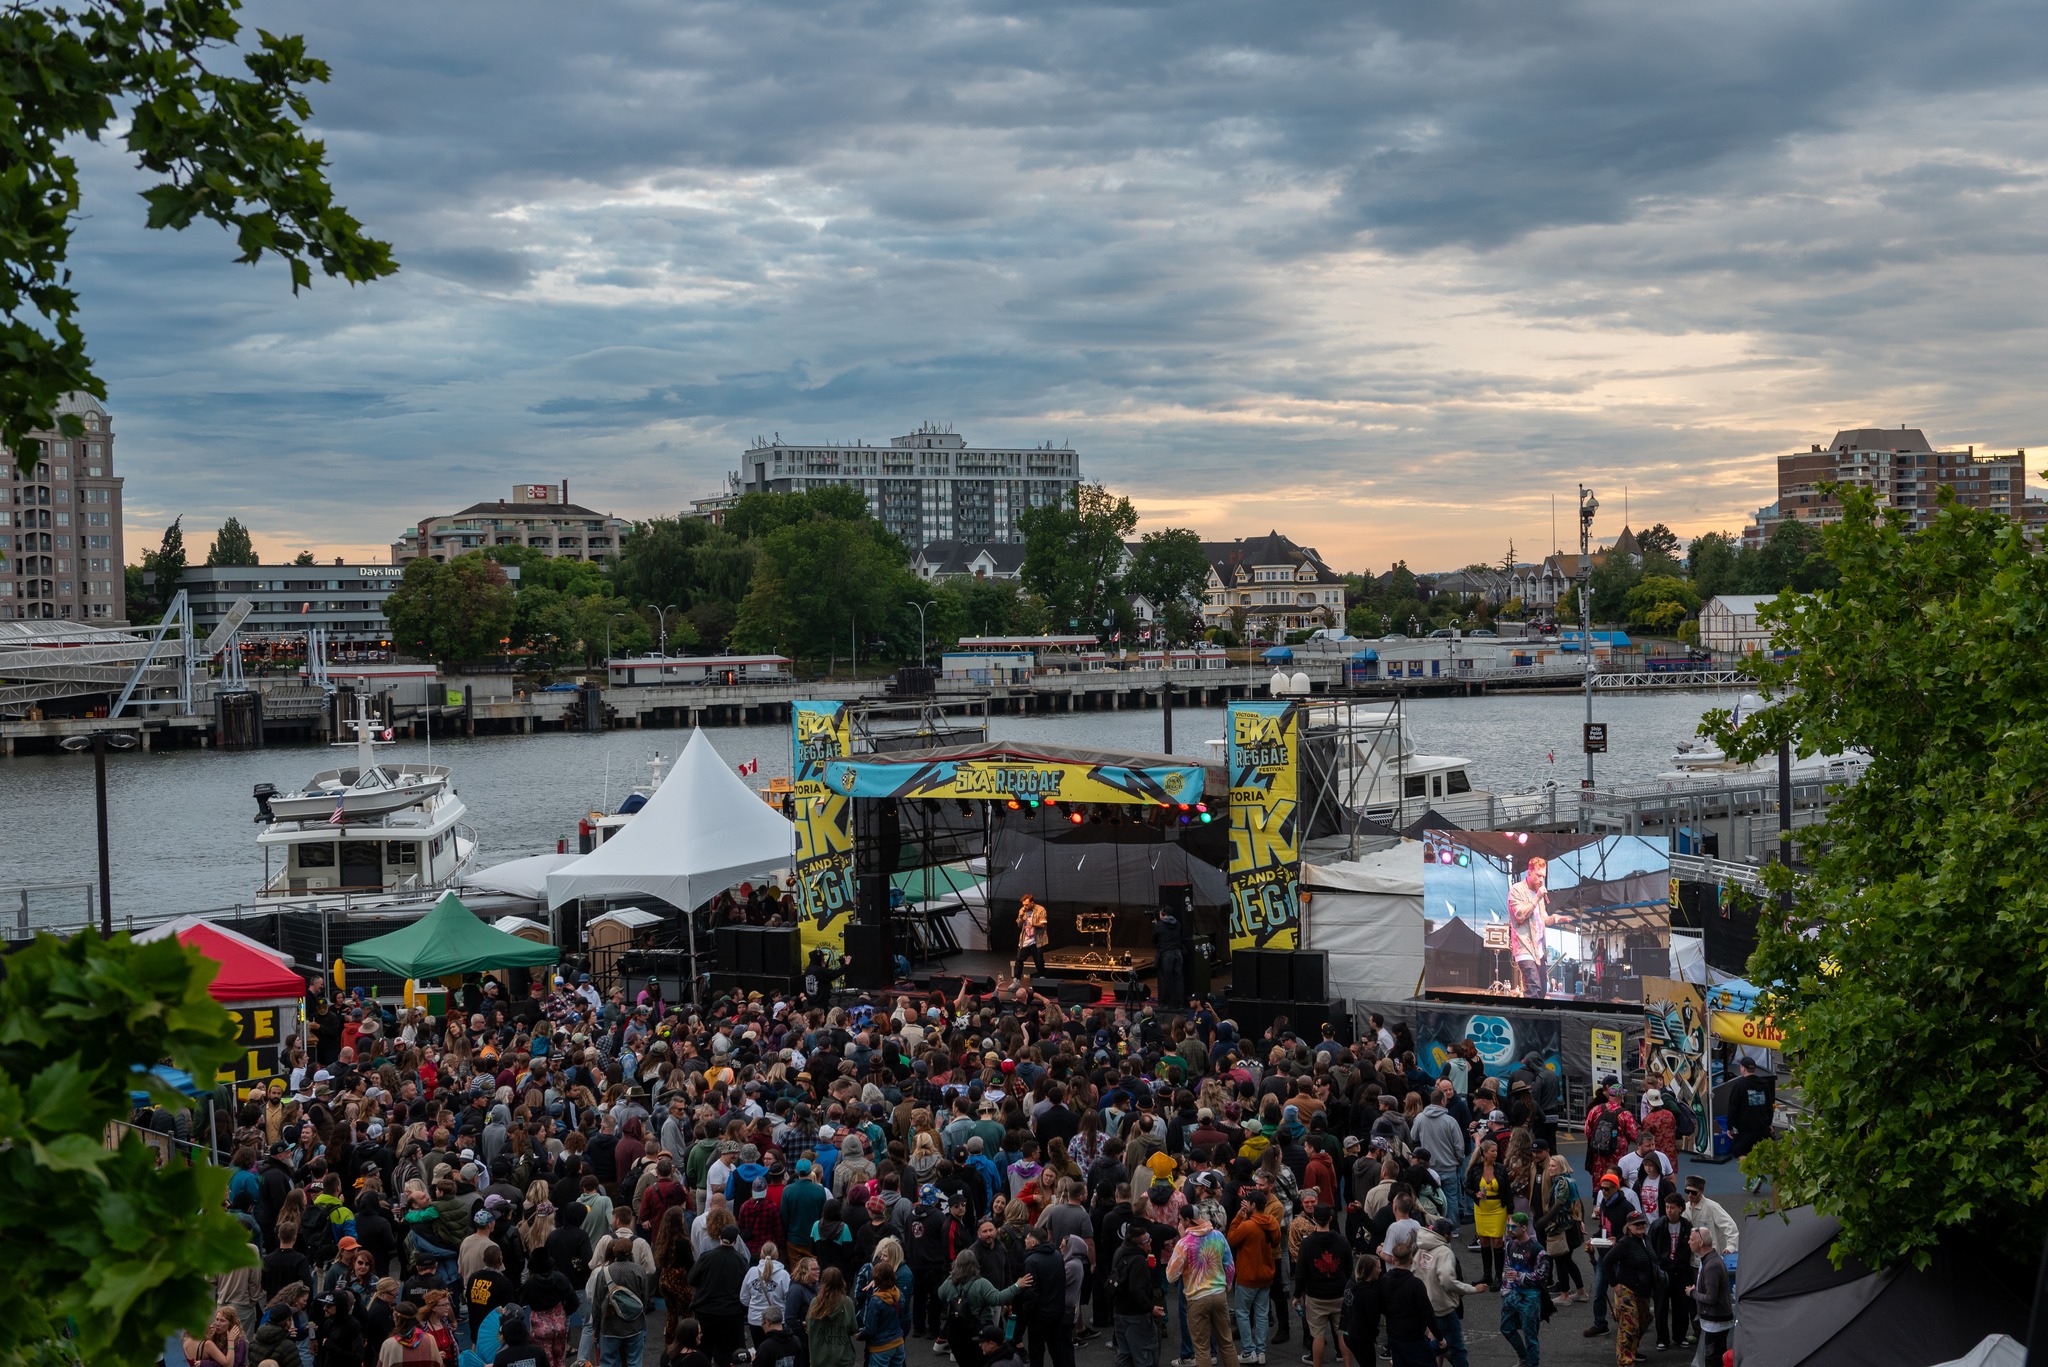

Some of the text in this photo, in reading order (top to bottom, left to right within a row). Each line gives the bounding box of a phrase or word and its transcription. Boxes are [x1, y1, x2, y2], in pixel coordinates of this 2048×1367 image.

[360, 567, 401, 577] Days Inn
[798, 715, 837, 741] SKA
[1235, 718, 1283, 746] SKA
[798, 743, 842, 761] REGGAE
[1235, 747, 1288, 767] REGGAE
[956, 770, 989, 792] SKA
[996, 770, 1060, 792] REGGAE
[1230, 791, 1265, 802] TORIA
[809, 858, 833, 873] AND
[1247, 870, 1276, 886] AND
